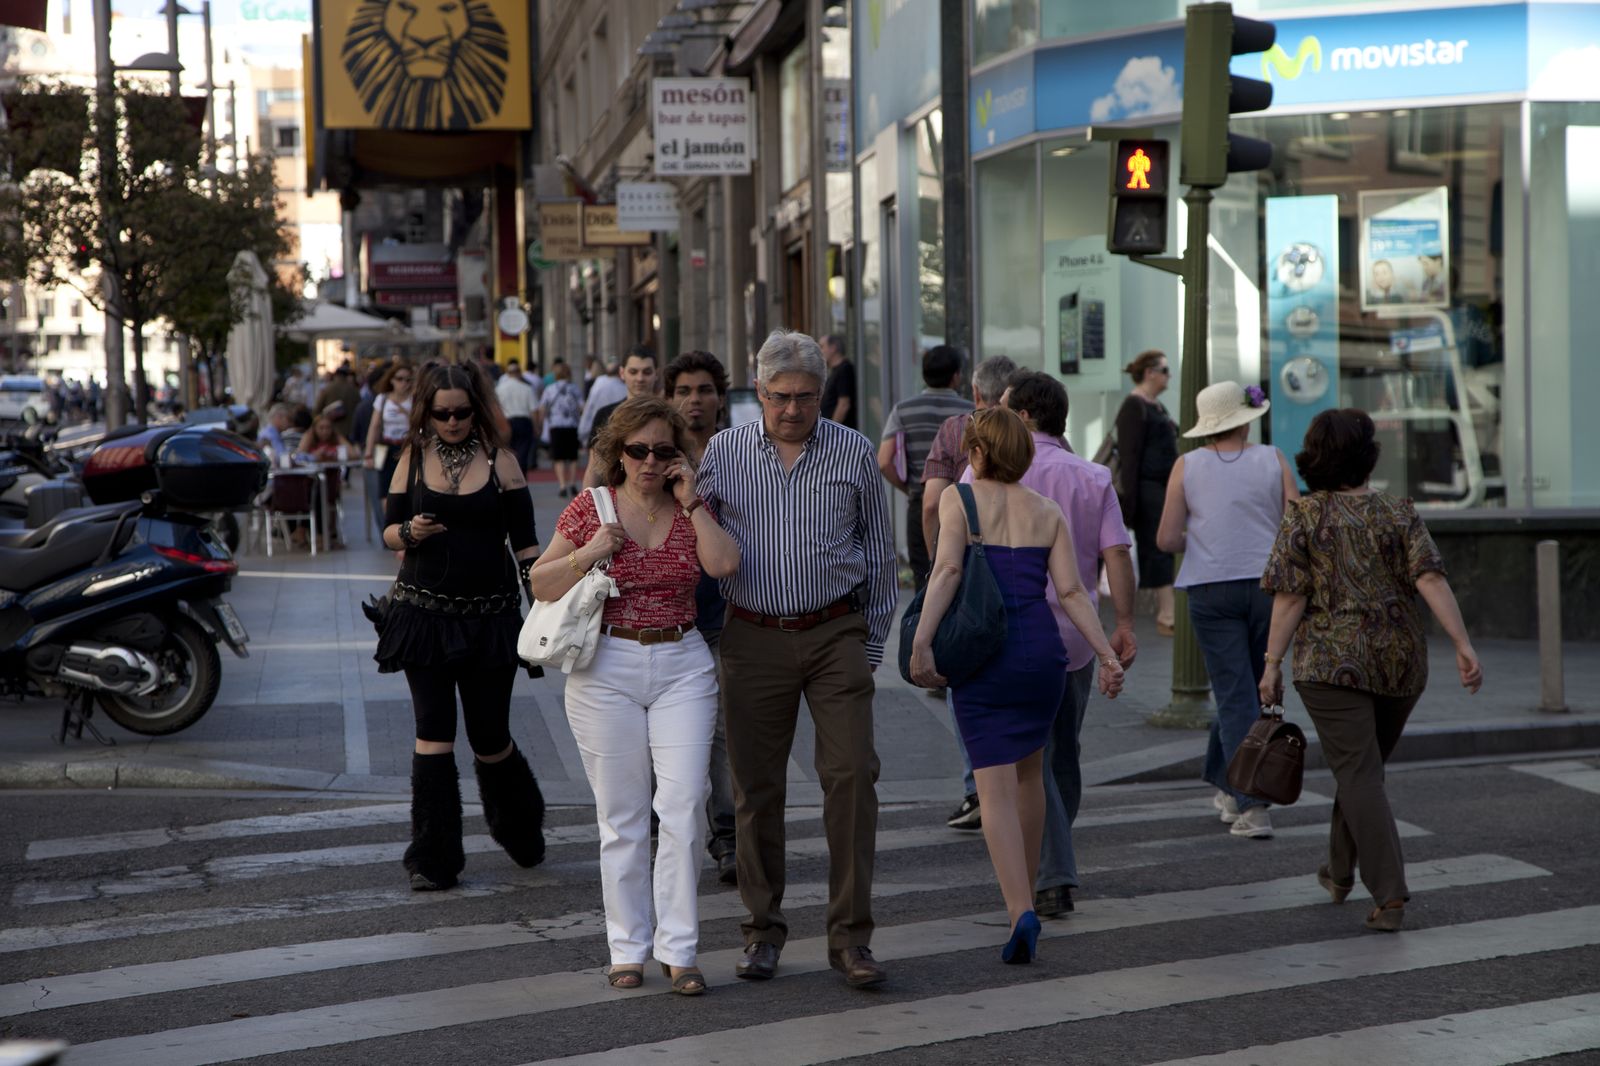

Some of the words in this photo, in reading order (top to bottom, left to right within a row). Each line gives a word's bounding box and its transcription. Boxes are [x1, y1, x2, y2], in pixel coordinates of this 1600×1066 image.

[1331, 38, 1468, 71] movistar
[661, 83, 744, 104] mesón
[658, 111, 682, 124] bar
[687, 111, 704, 124] de
[708, 112, 746, 127] tapas
[661, 139, 678, 155] el
[684, 137, 745, 159] jamón
[1059, 255, 1090, 268] iPhone
